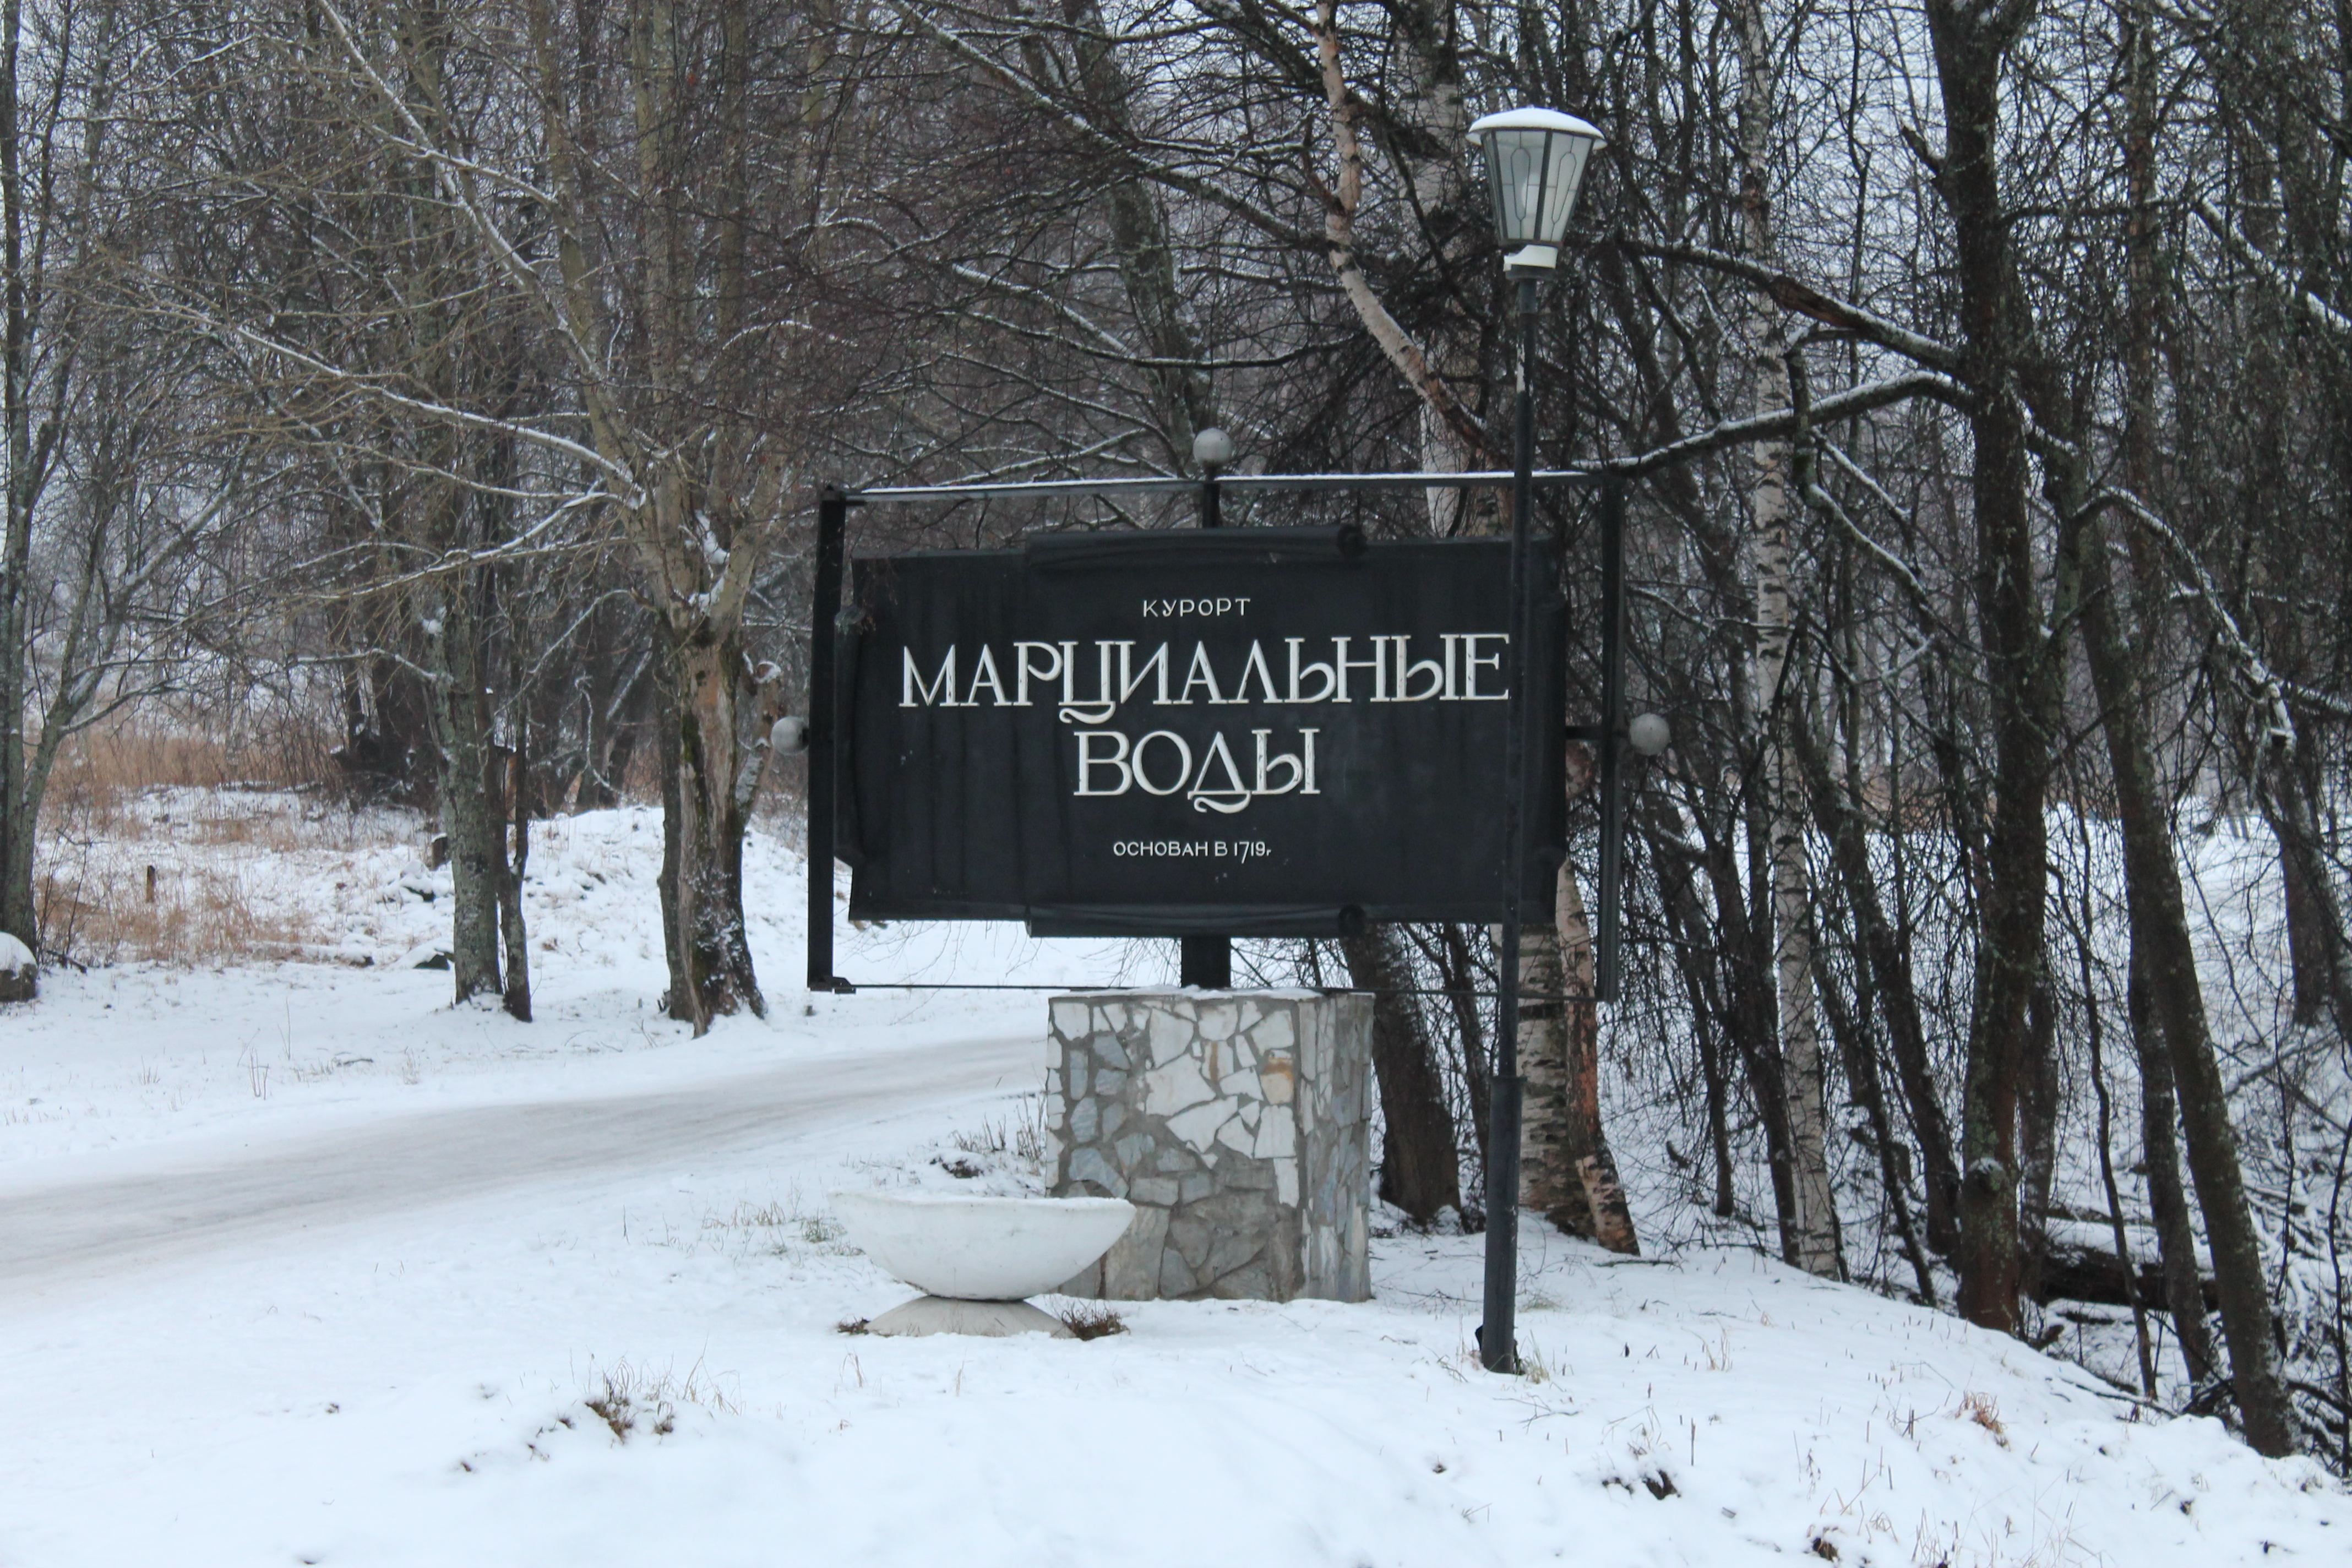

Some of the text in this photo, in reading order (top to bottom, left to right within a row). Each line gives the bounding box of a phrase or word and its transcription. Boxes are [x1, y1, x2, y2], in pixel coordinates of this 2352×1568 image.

[1143, 598, 1251, 617] КУРОРТ
[899, 633, 1510, 724] МАРЦИАЛЬНЫЕ
[1073, 728, 1321, 814] ВОДЫ
[1113, 841, 1208, 857] ОСНОВАН
[1215, 841, 1228, 857] В
